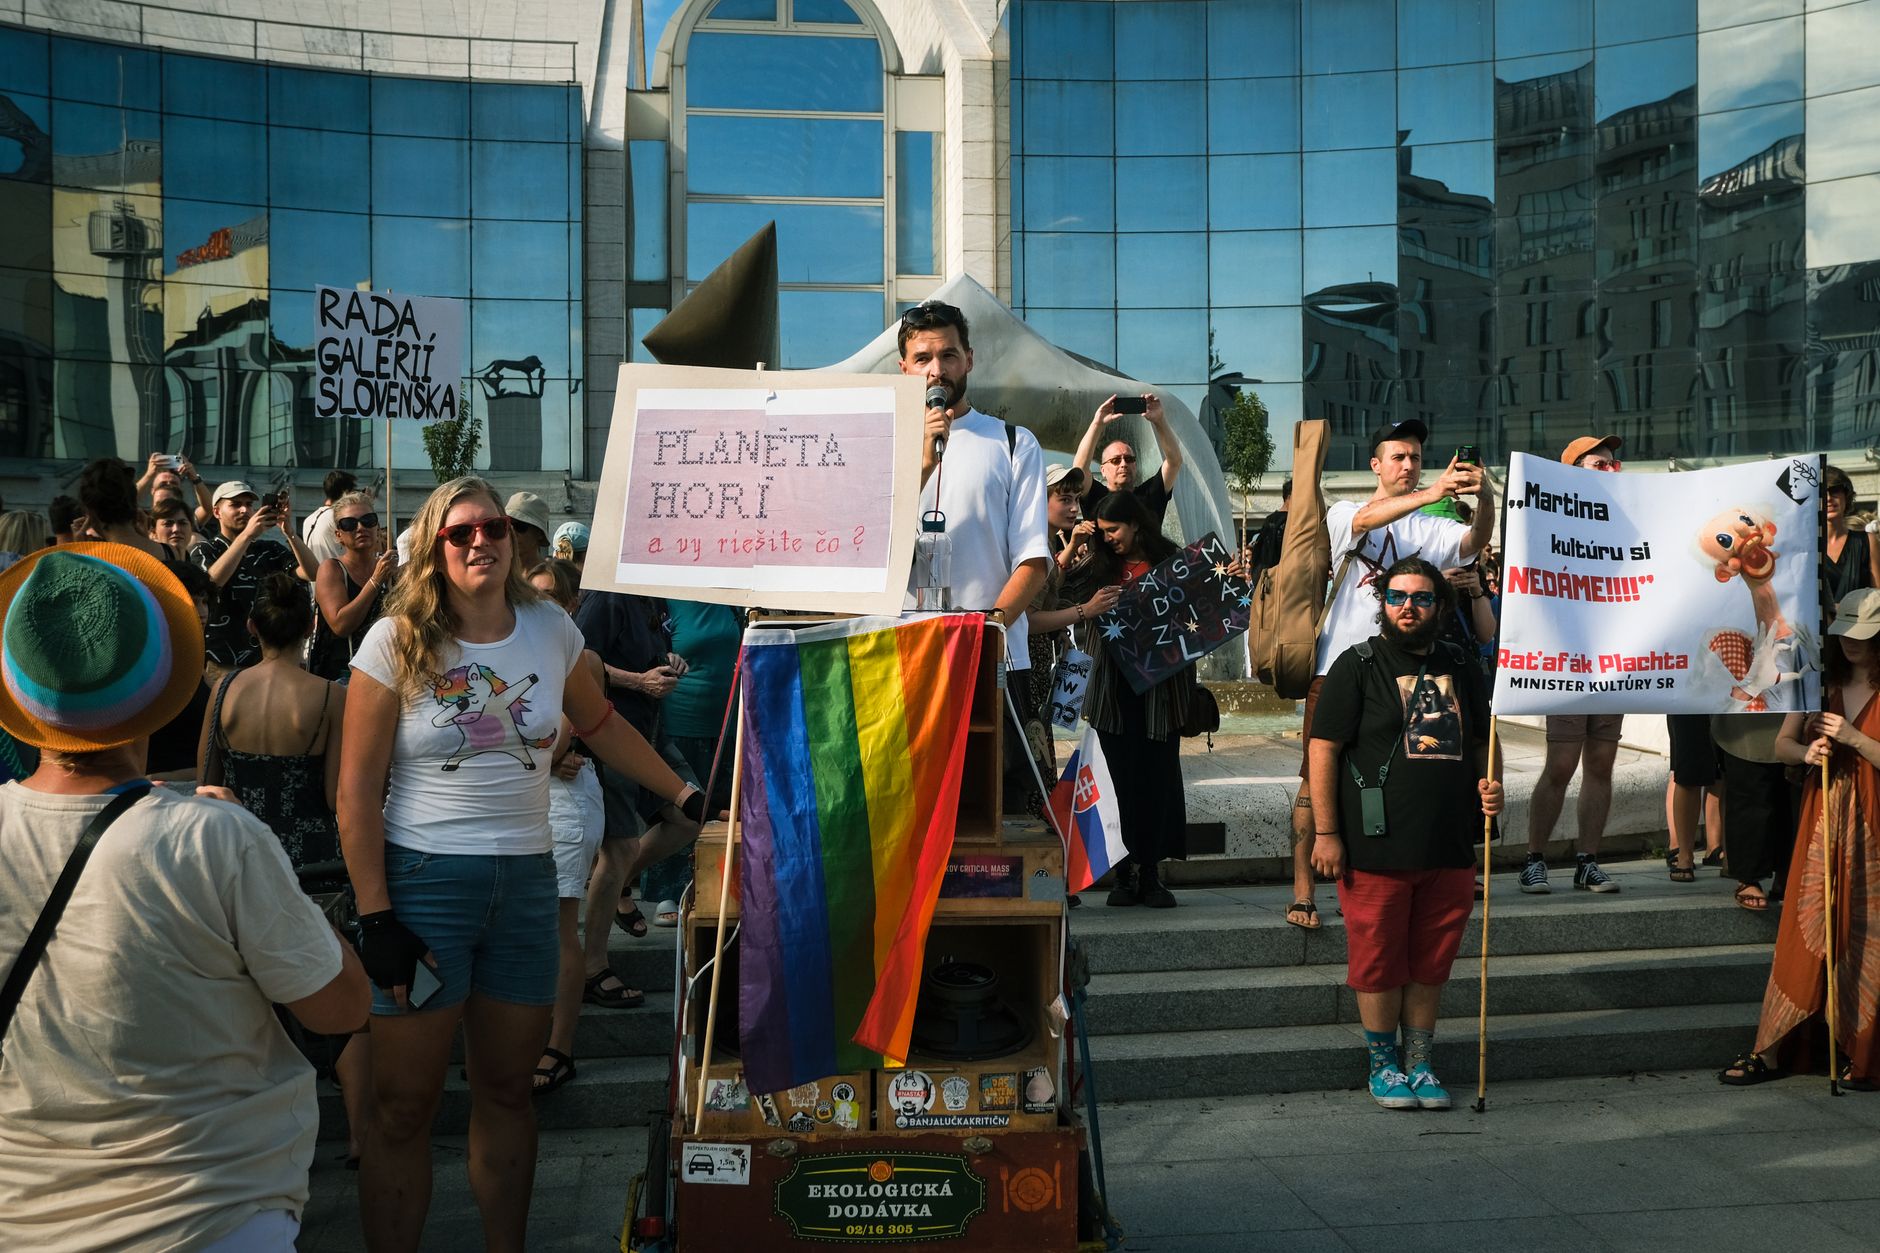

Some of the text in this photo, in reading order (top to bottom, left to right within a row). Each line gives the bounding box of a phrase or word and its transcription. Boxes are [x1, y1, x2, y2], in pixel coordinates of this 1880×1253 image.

[320, 288, 421, 341] RADA
[318, 333, 436, 383] GALÉRIÍ
[317, 376, 456, 420] SLOVENSKA
[648, 476, 775, 519] HORÍ
[648, 525, 865, 562] a vy riešite čo ?
[1551, 534, 1651, 561] kultúru si
[1600, 650, 1688, 674] Plachta
[1509, 674, 1675, 693] MINISTER KULTÚRY SR
[960, 864, 989, 873] CRITICAL
[991, 864, 1010, 873] MASS
[808, 1179, 953, 1198] EKOLOGICKÁ
[828, 1200, 932, 1218] DODÁVKA
[846, 1224, 913, 1236] 02/16 305
